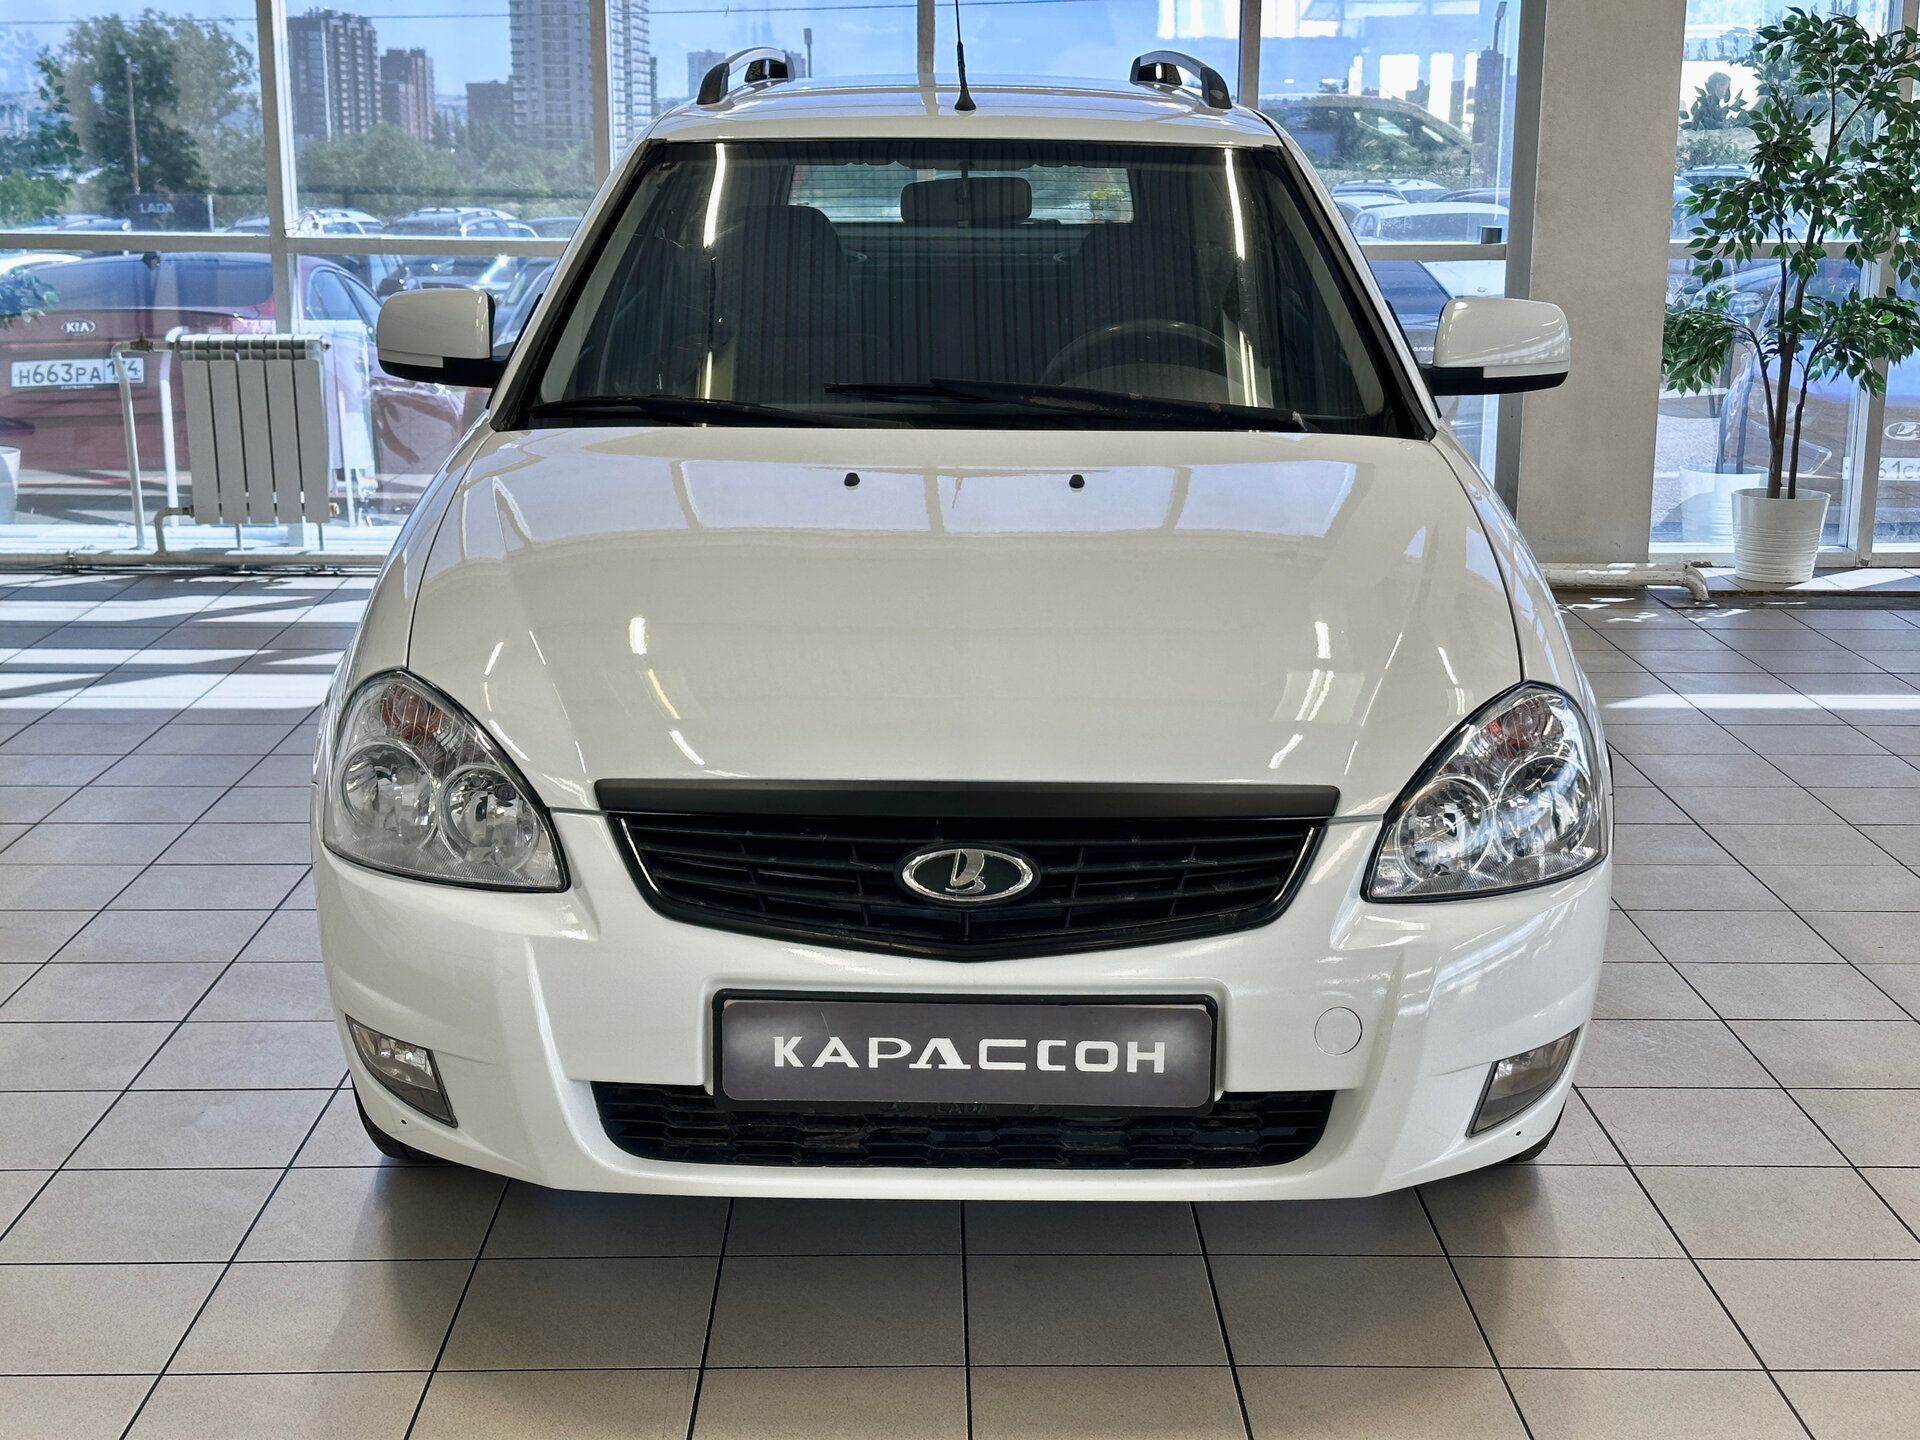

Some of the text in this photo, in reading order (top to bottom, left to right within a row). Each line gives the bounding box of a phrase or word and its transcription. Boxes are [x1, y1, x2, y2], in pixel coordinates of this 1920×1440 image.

[139, 203, 175, 213] LADA
[66, 322, 90, 333] KIA
[19, 360, 138, 384] Н663РА 14
[773, 1036, 1166, 1074] КАРЛССОН
